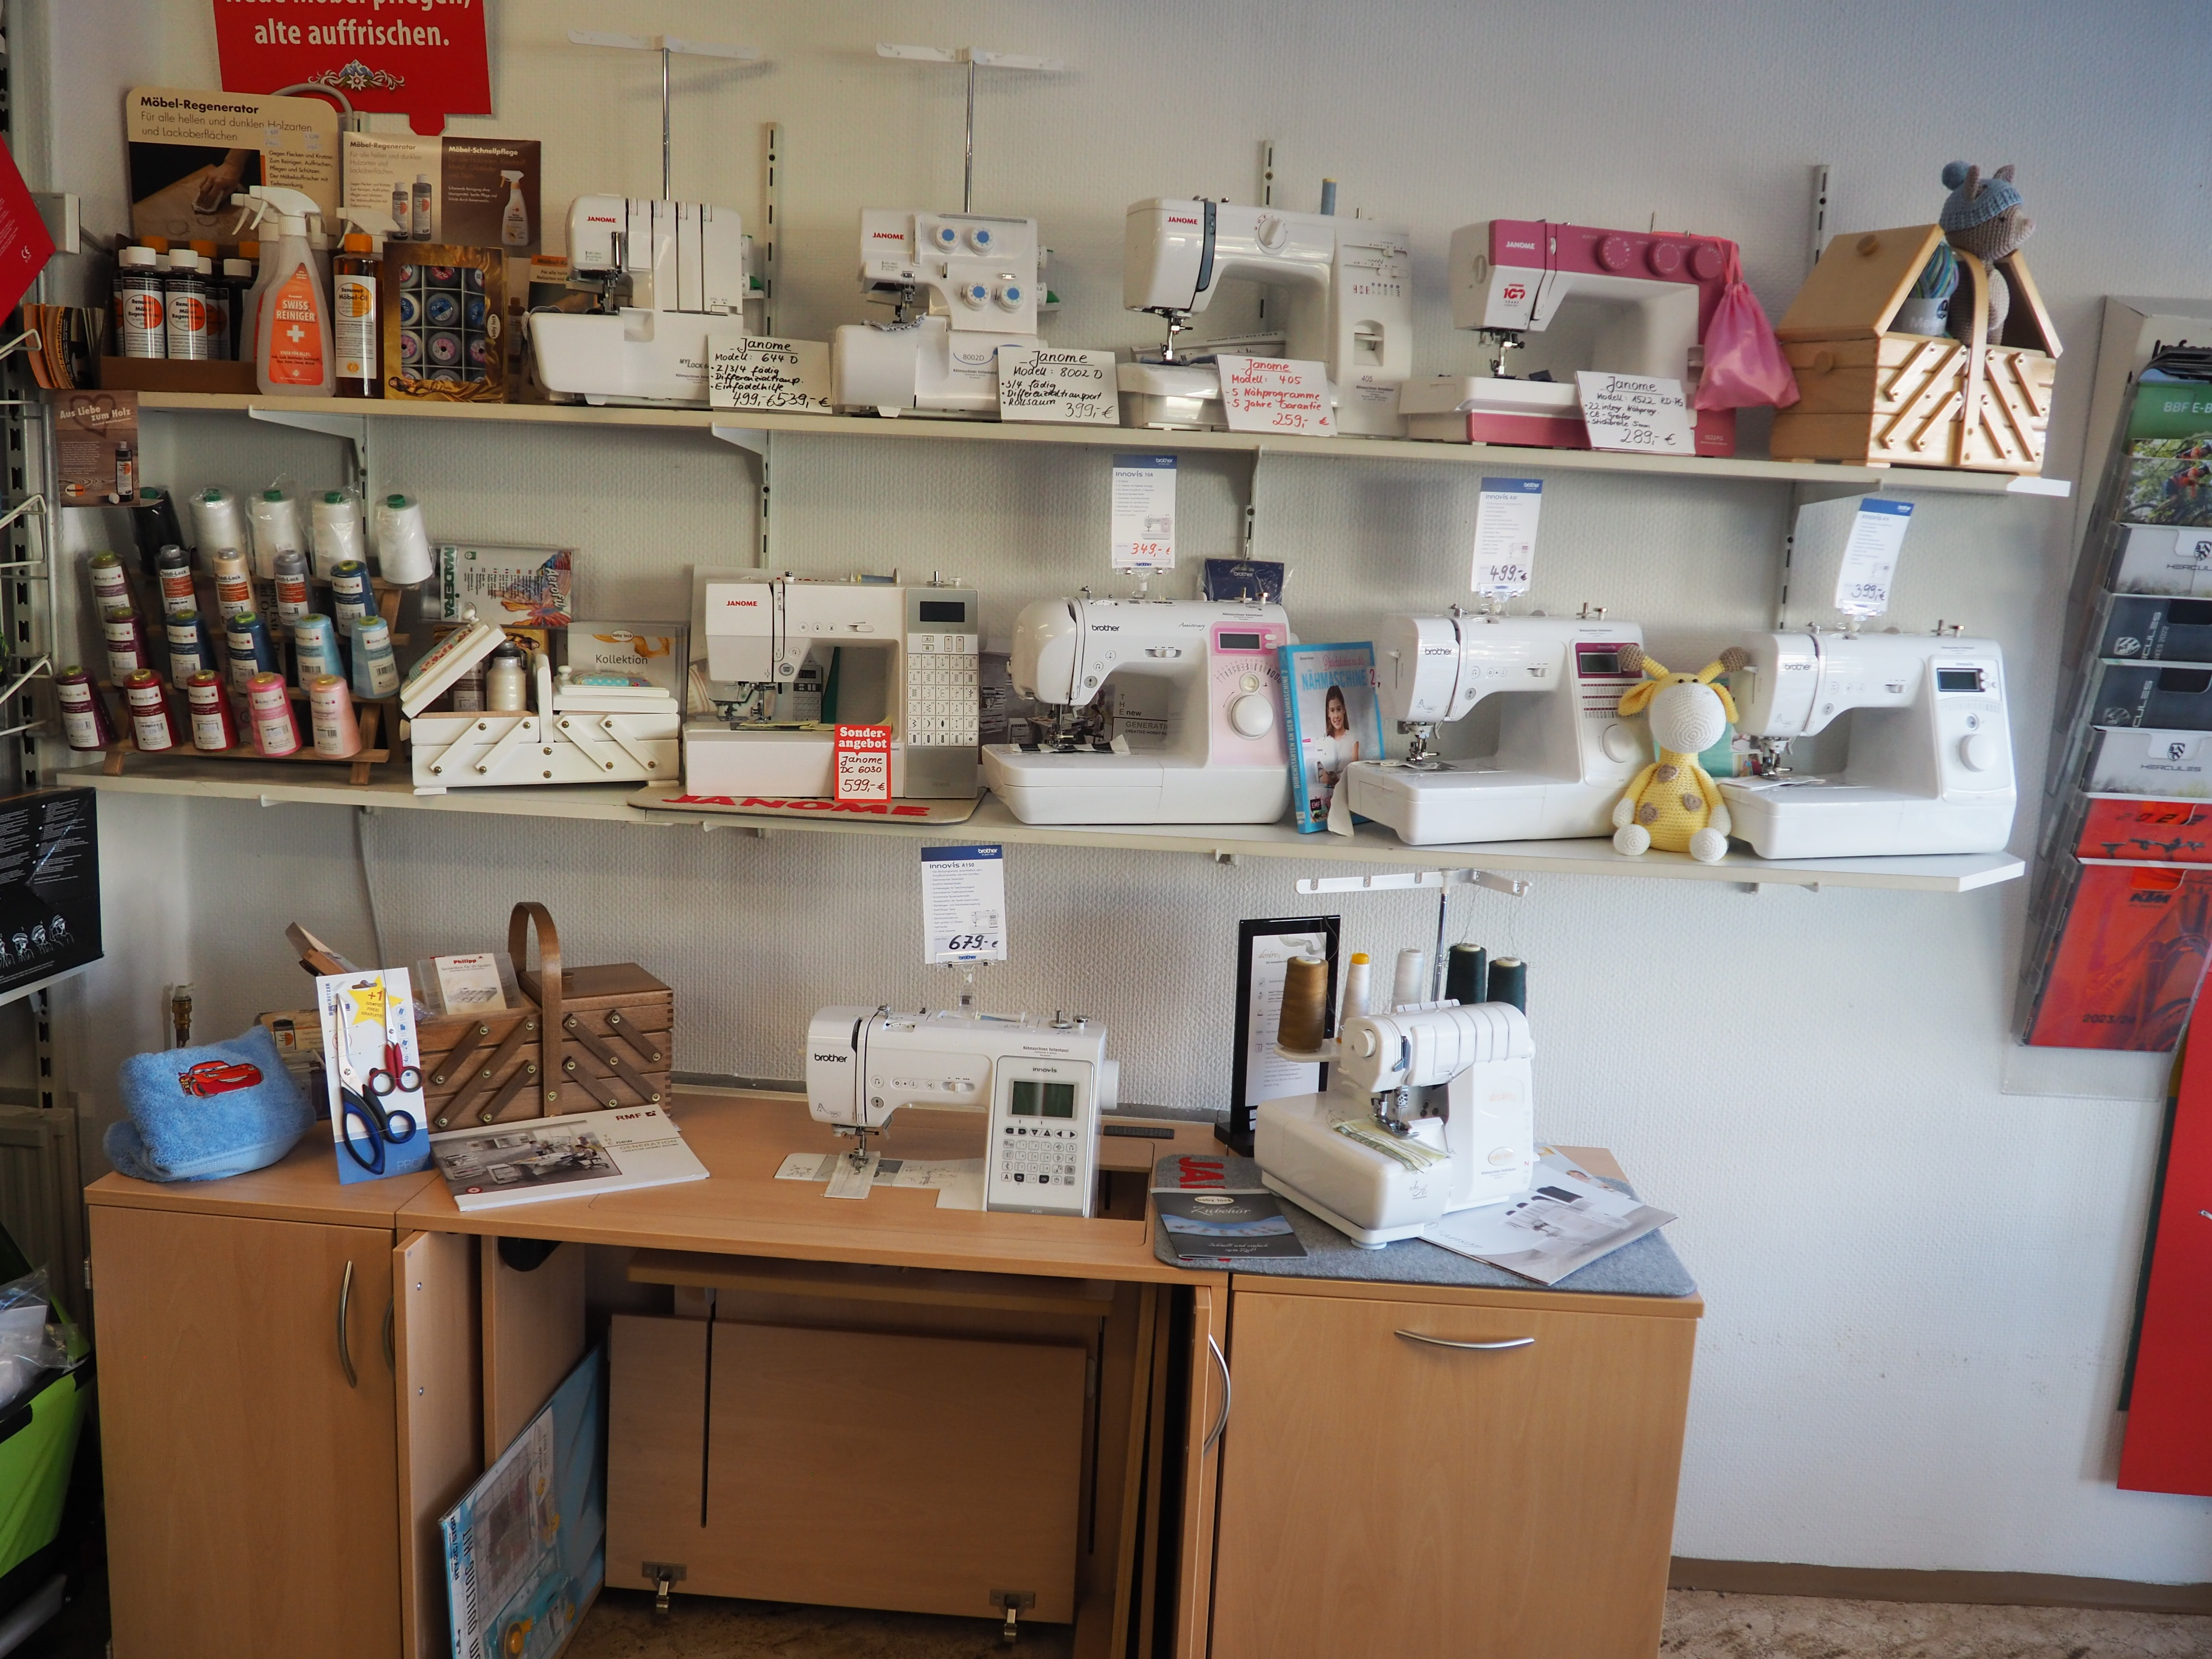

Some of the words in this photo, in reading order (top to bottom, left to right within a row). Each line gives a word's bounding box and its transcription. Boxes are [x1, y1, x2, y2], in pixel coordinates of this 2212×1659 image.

[254, 18, 301, 44] alte
[308, 19, 449, 46] auffrischen.
[141, 96, 259, 114] Möbel-Regenerator
[141, 111, 155, 120] Für
[158, 113, 175, 122] alle
[179, 114, 205, 125] hellen
[209, 116, 226, 126] und
[229, 118, 264, 129] dunklen
[268, 120, 312, 132] Holzarten
[142, 127, 159, 136] und
[163, 128, 238, 141] Lackoberflächen
[350, 142, 416, 151] Möbel-Regenerator
[448, 146, 518, 156] Möbel-Schnellpflege
[1167, 216, 1198, 225] JANOME
[872, 232, 904, 240] JANOME
[1506, 241, 1535, 250] JANOME
[1503, 288, 1526, 300] 100
[283, 300, 309, 310] SWISS
[276, 311, 315, 321] REINIGER
[737, 337, 792, 353] Janome
[715, 353, 752, 361] Modell:
[761, 353, 785, 362] 644
[1029, 350, 1088, 368] Janome
[716, 364, 746, 374] 2/3/4
[751, 366, 780, 376] fädig
[1060, 367, 1089, 378] 8002
[1094, 370, 1103, 379] D
[1245, 359, 1289, 375] Janome
[1006, 379, 1022, 388] 3/4
[1028, 379, 1056, 391] fädig
[1232, 374, 1268, 384] Modell:
[1279, 375, 1302, 385] 405
[1606, 376, 1658, 393] Janome
[715, 382, 784, 393] Einfädelhilfe
[1007, 389, 1102, 403] Differenzialtransport
[1244, 387, 1320, 402] Nähprogramme
[1632, 395, 1656, 404] 1522
[1244, 400, 1272, 411] Jahre
[1280, 399, 1321, 410] Garantie
[1589, 402, 1602, 410] 22
[2164, 402, 2189, 413] BBF
[60, 409, 76, 419] Aus
[77, 405, 101, 417] Liebe
[91, 412, 110, 421] zum
[111, 409, 131, 419] Holz
[1608, 413, 1632, 421] Greifer
[1592, 419, 1629, 427] Stichbreite
[444, 546, 455, 618] MADEIRA
[545, 567, 567, 608] Aerofil
[1178, 622, 1206, 631] Anniversary
[1425, 648, 1453, 656] brother
[596, 654, 648, 665] Kollektion
[1301, 669, 1367, 690] NÄHMASCHINE
[1370, 668, 1375, 685] 2
[1282, 675, 1292, 718] NÄHMASCHINE
[1286, 719, 1294, 731] DER
[840, 726, 886, 737] Sonder-
[1287, 733, 1295, 741] AN
[839, 738, 887, 750] angebot
[841, 756, 883, 766] Janome
[1288, 743, 1300, 789] DURCHSTARTEN
[2140, 764, 2201, 772] HERCULES
[662, 794, 930, 816] JANOME
[2129, 890, 2172, 903] KTM
[368, 990, 383, 1001] +1
[814, 1053, 848, 1064] brother
[615, 1113, 641, 1121] RMF
[620, 1139, 677, 1150] GENERATION
[1191, 1206, 1252, 1216] Zubehör
[462, 1527, 473, 1556] KIT
[464, 1559, 479, 1635] QUILTING
